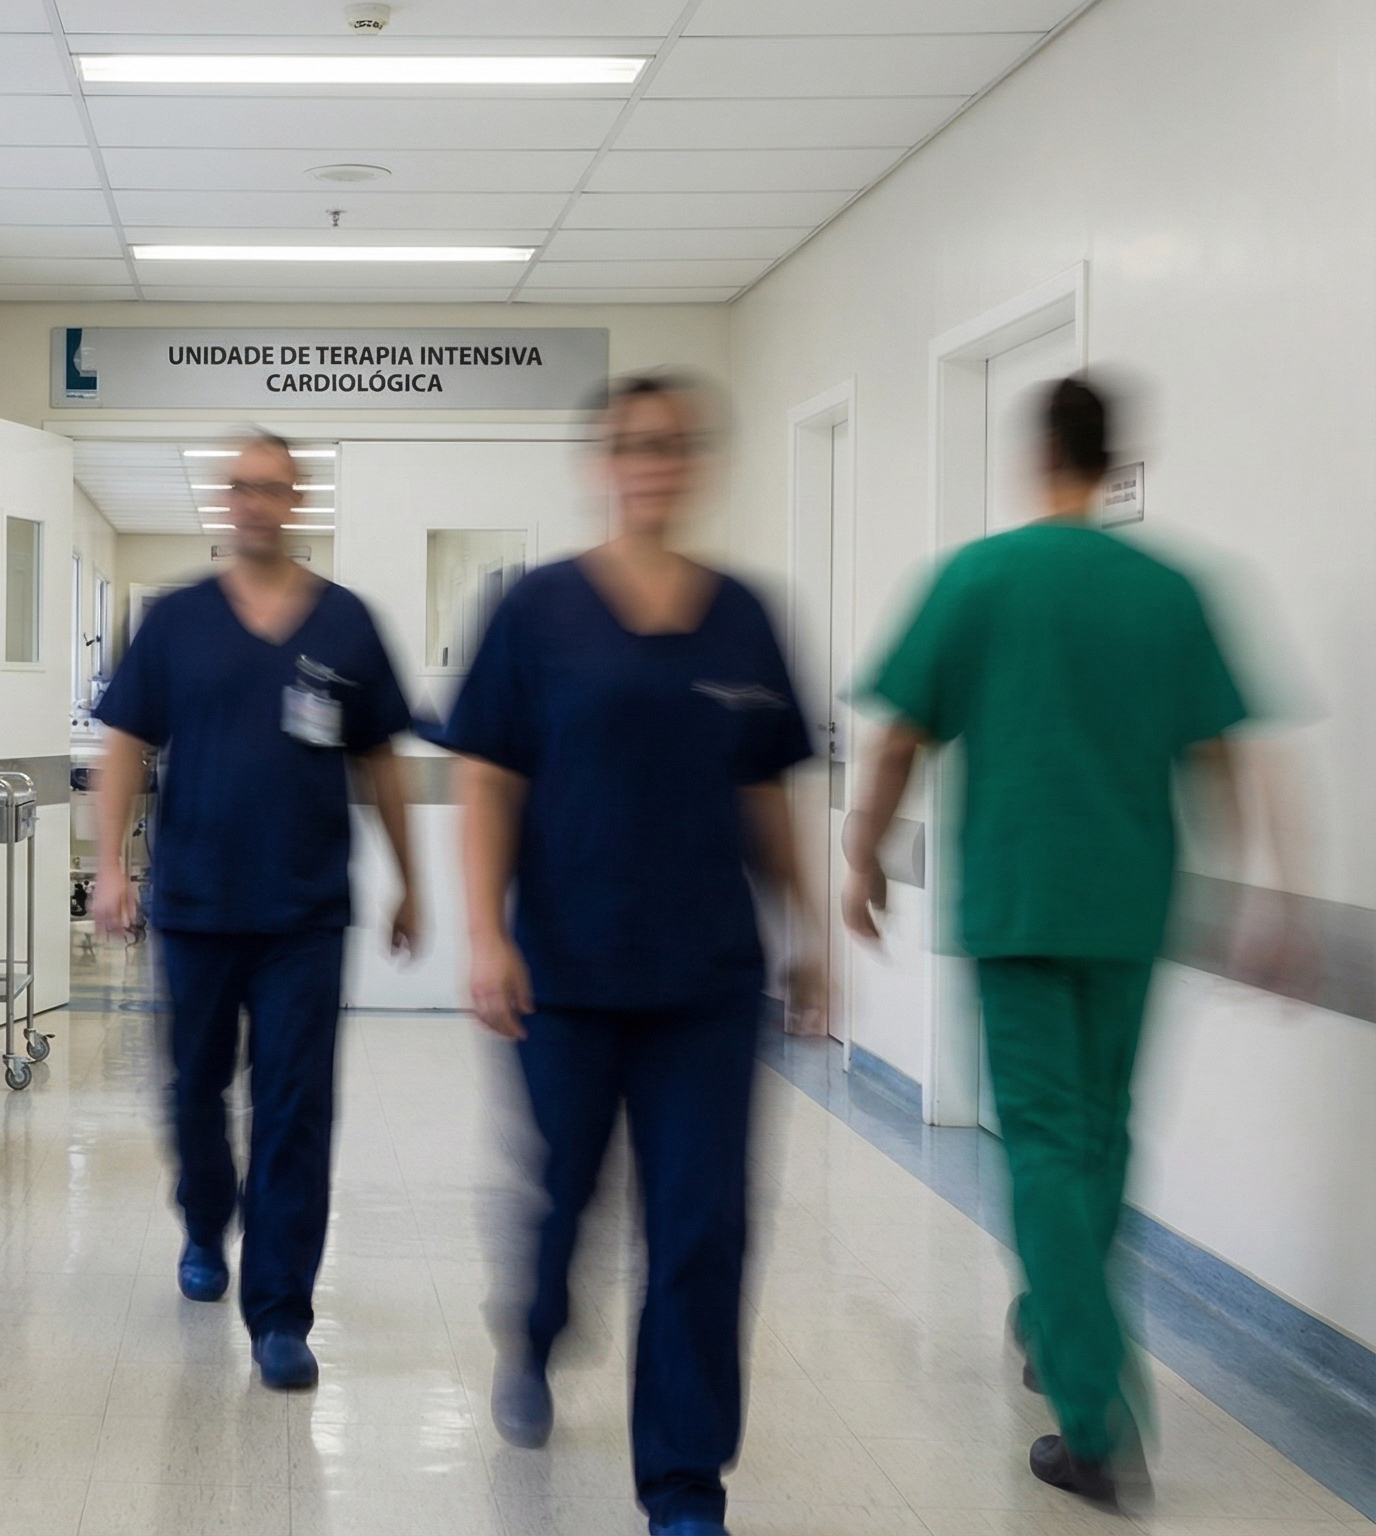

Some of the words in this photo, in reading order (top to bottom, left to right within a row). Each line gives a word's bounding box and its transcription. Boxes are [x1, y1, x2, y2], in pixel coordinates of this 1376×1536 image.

[168, 346, 274, 365] UNIDADE
[280, 346, 310, 365] DE
[316, 346, 414, 365] TERAPIA
[420, 346, 543, 366] INTENSIVA
[266, 370, 443, 392] CARDIOLÓGICA
